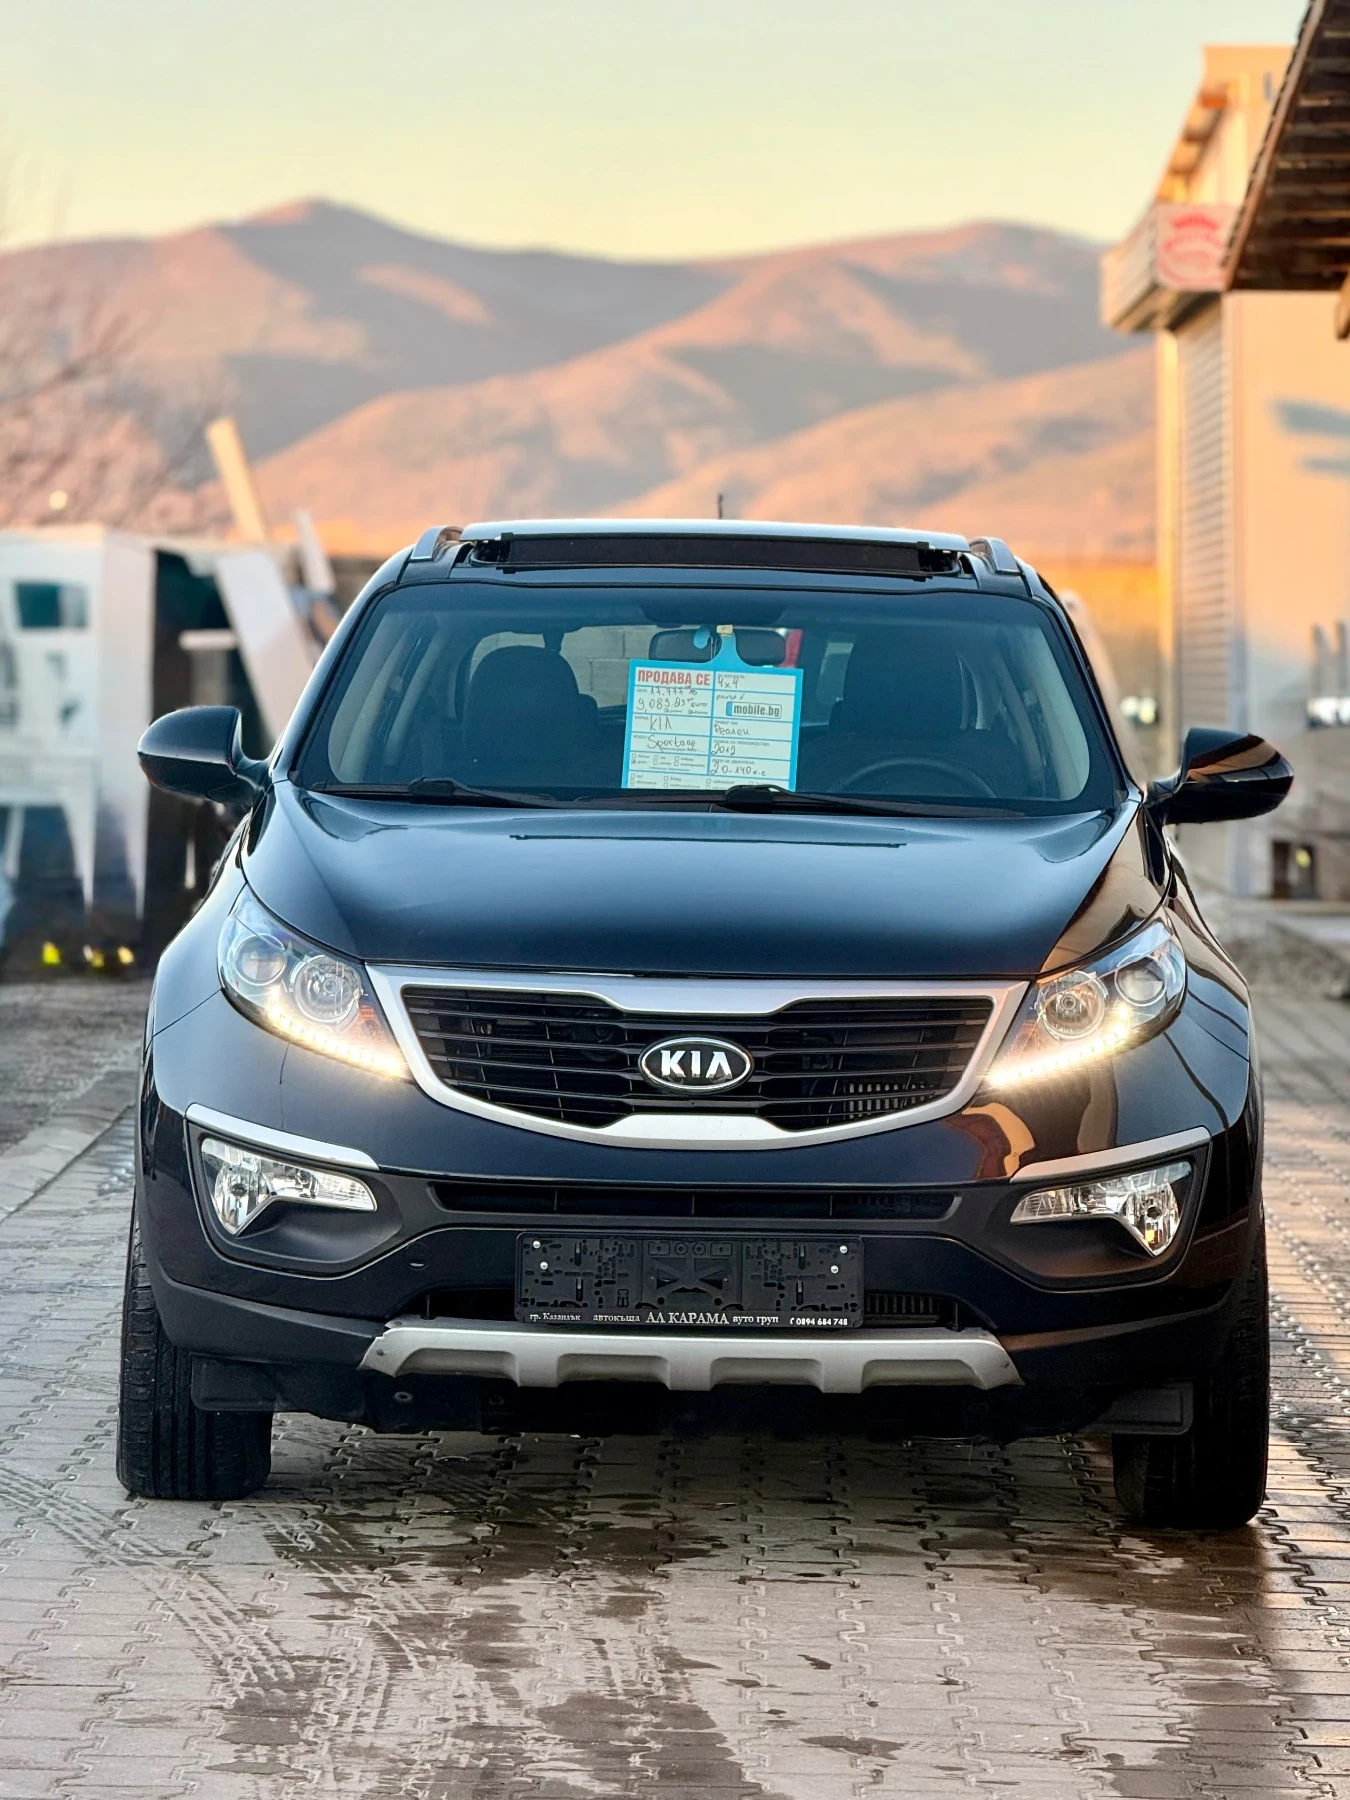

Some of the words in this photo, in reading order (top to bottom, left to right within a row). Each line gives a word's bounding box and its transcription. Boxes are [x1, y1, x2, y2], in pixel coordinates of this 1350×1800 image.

[638, 670, 692, 685] ПРОДАВА
[695, 673, 711, 686] СЕ
[733, 704, 780, 717] mobile.bg
[647, 734, 696, 753] Sportage
[661, 1050, 733, 1079] KIA
[645, 1311, 666, 1324] АЛ
[668, 1312, 730, 1325] КАРАМА
[732, 1316, 753, 1324] ауто
[756, 1316, 779, 1326] груп
[796, 1318, 816, 1326] 0894
[817, 1318, 832, 1326] 684
[833, 1318, 848, 1326] 748
